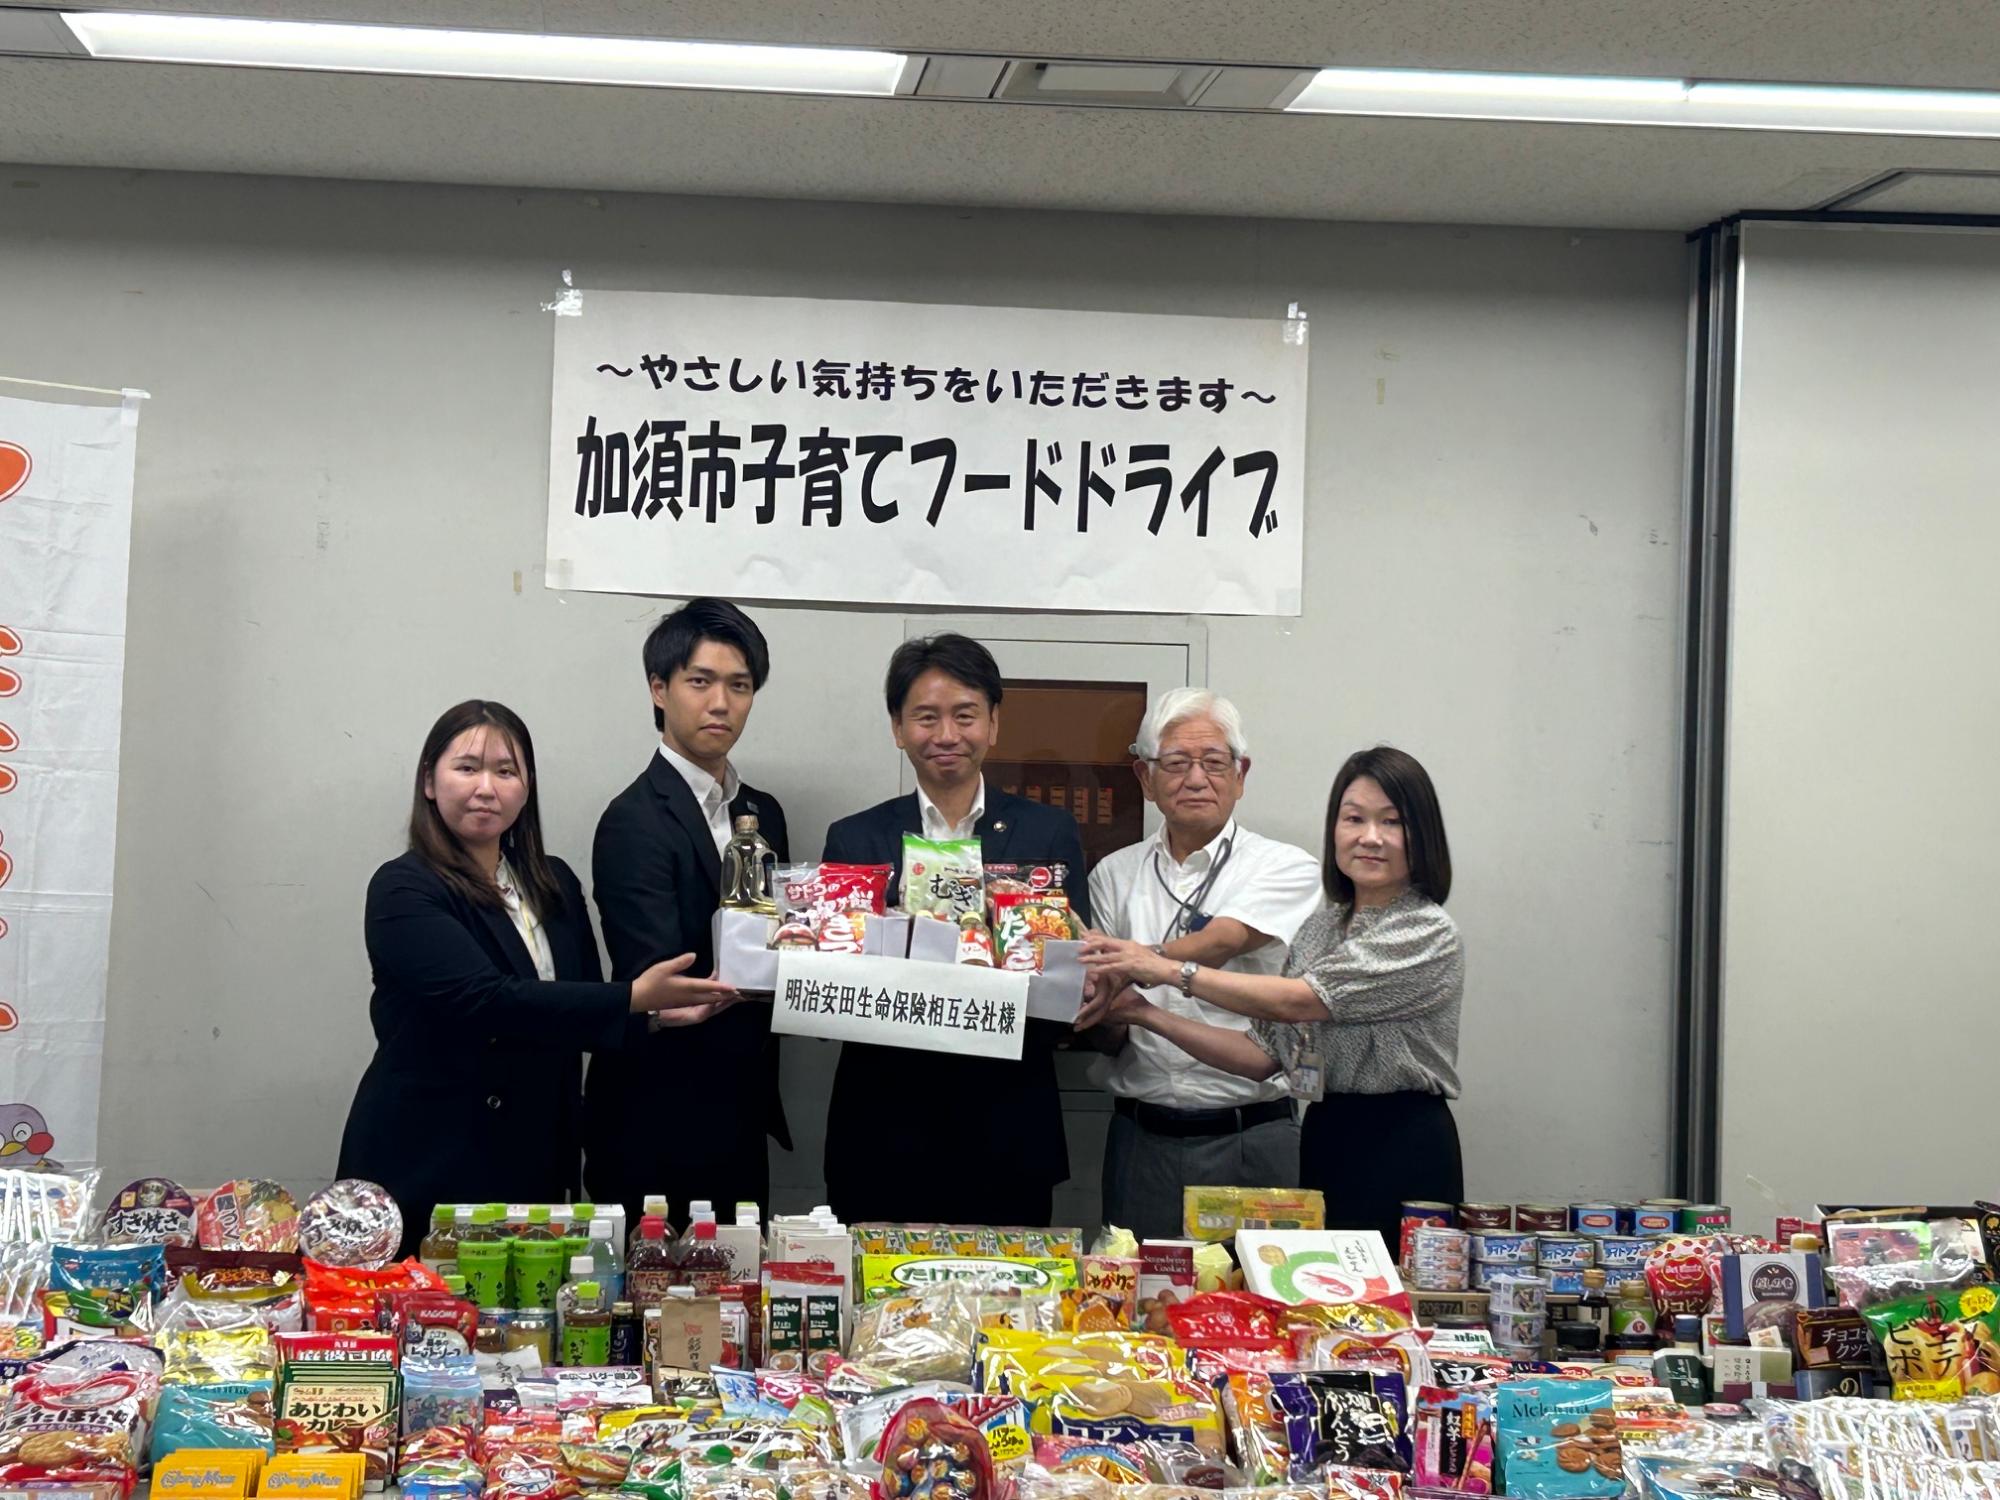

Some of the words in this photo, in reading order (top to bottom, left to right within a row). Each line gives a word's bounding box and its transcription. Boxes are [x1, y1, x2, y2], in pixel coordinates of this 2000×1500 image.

[574, 414, 1280, 540] 加須市子育てフードドライブ
[785, 977, 1017, 1036] 明治安田生命保険相互会社様
[420, 1309, 458, 1319] KAGOME
[288, 1402, 382, 1418] あじわい
[305, 1419, 364, 1433] カレー
